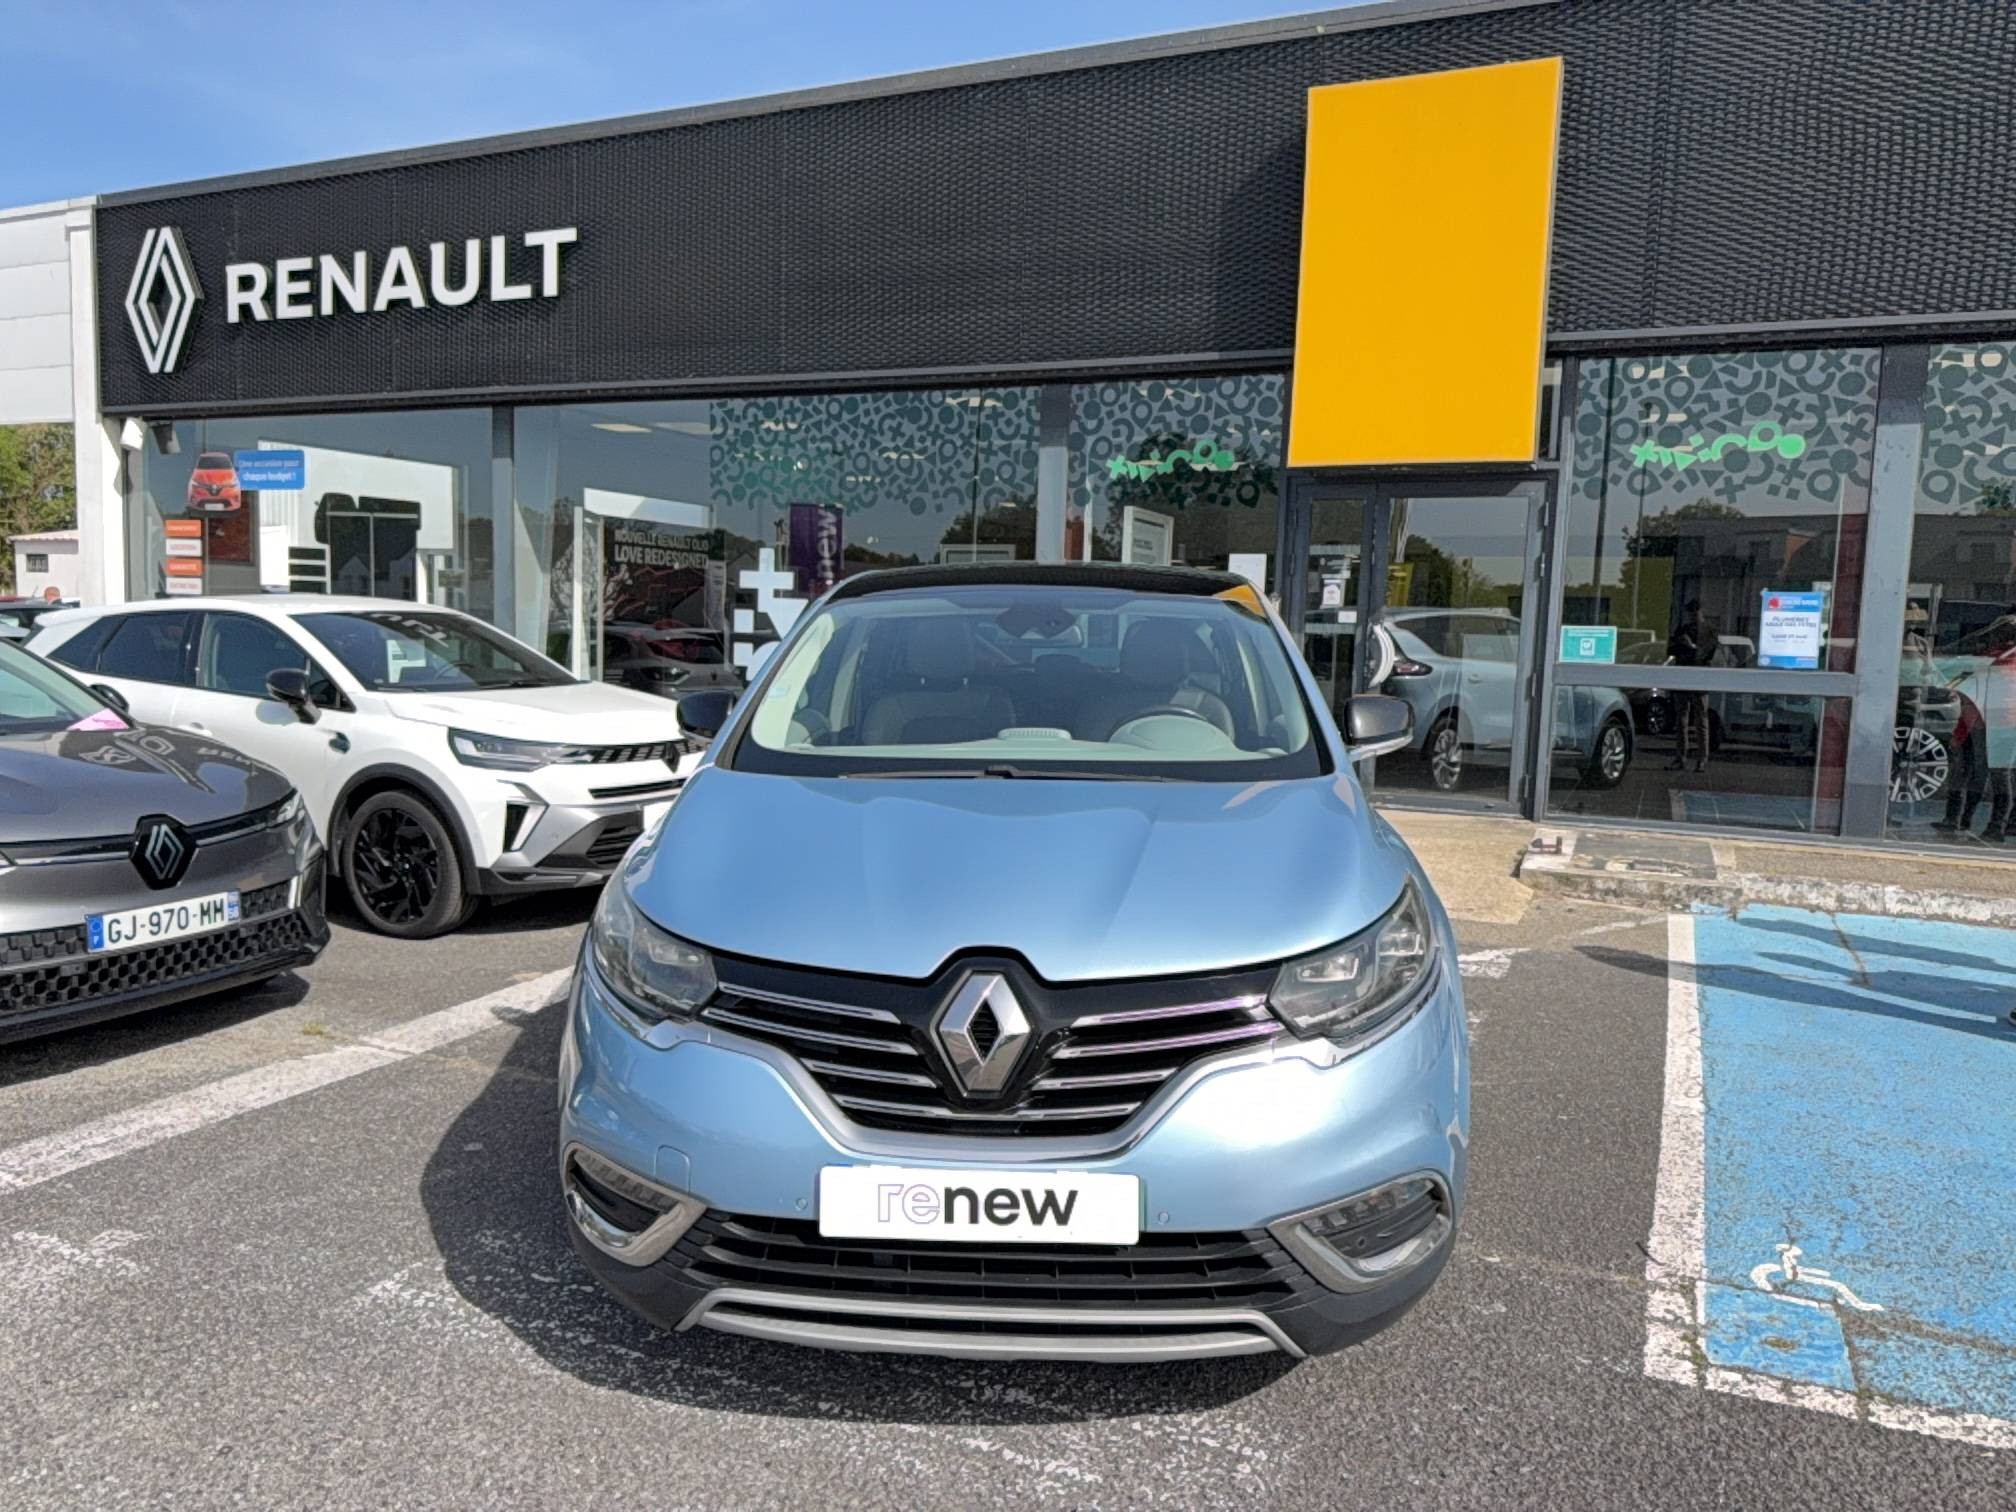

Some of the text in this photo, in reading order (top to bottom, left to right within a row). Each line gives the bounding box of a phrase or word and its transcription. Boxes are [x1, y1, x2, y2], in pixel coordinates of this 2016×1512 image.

[226, 228, 578, 324] RENAULT
[242, 471, 266, 482] chaque
[267, 471, 291, 483] budget
[614, 544, 709, 570] LOVE REDESIGNED
[108, 898, 224, 944] GJ-970-MM
[877, 1184, 1079, 1226] renew
